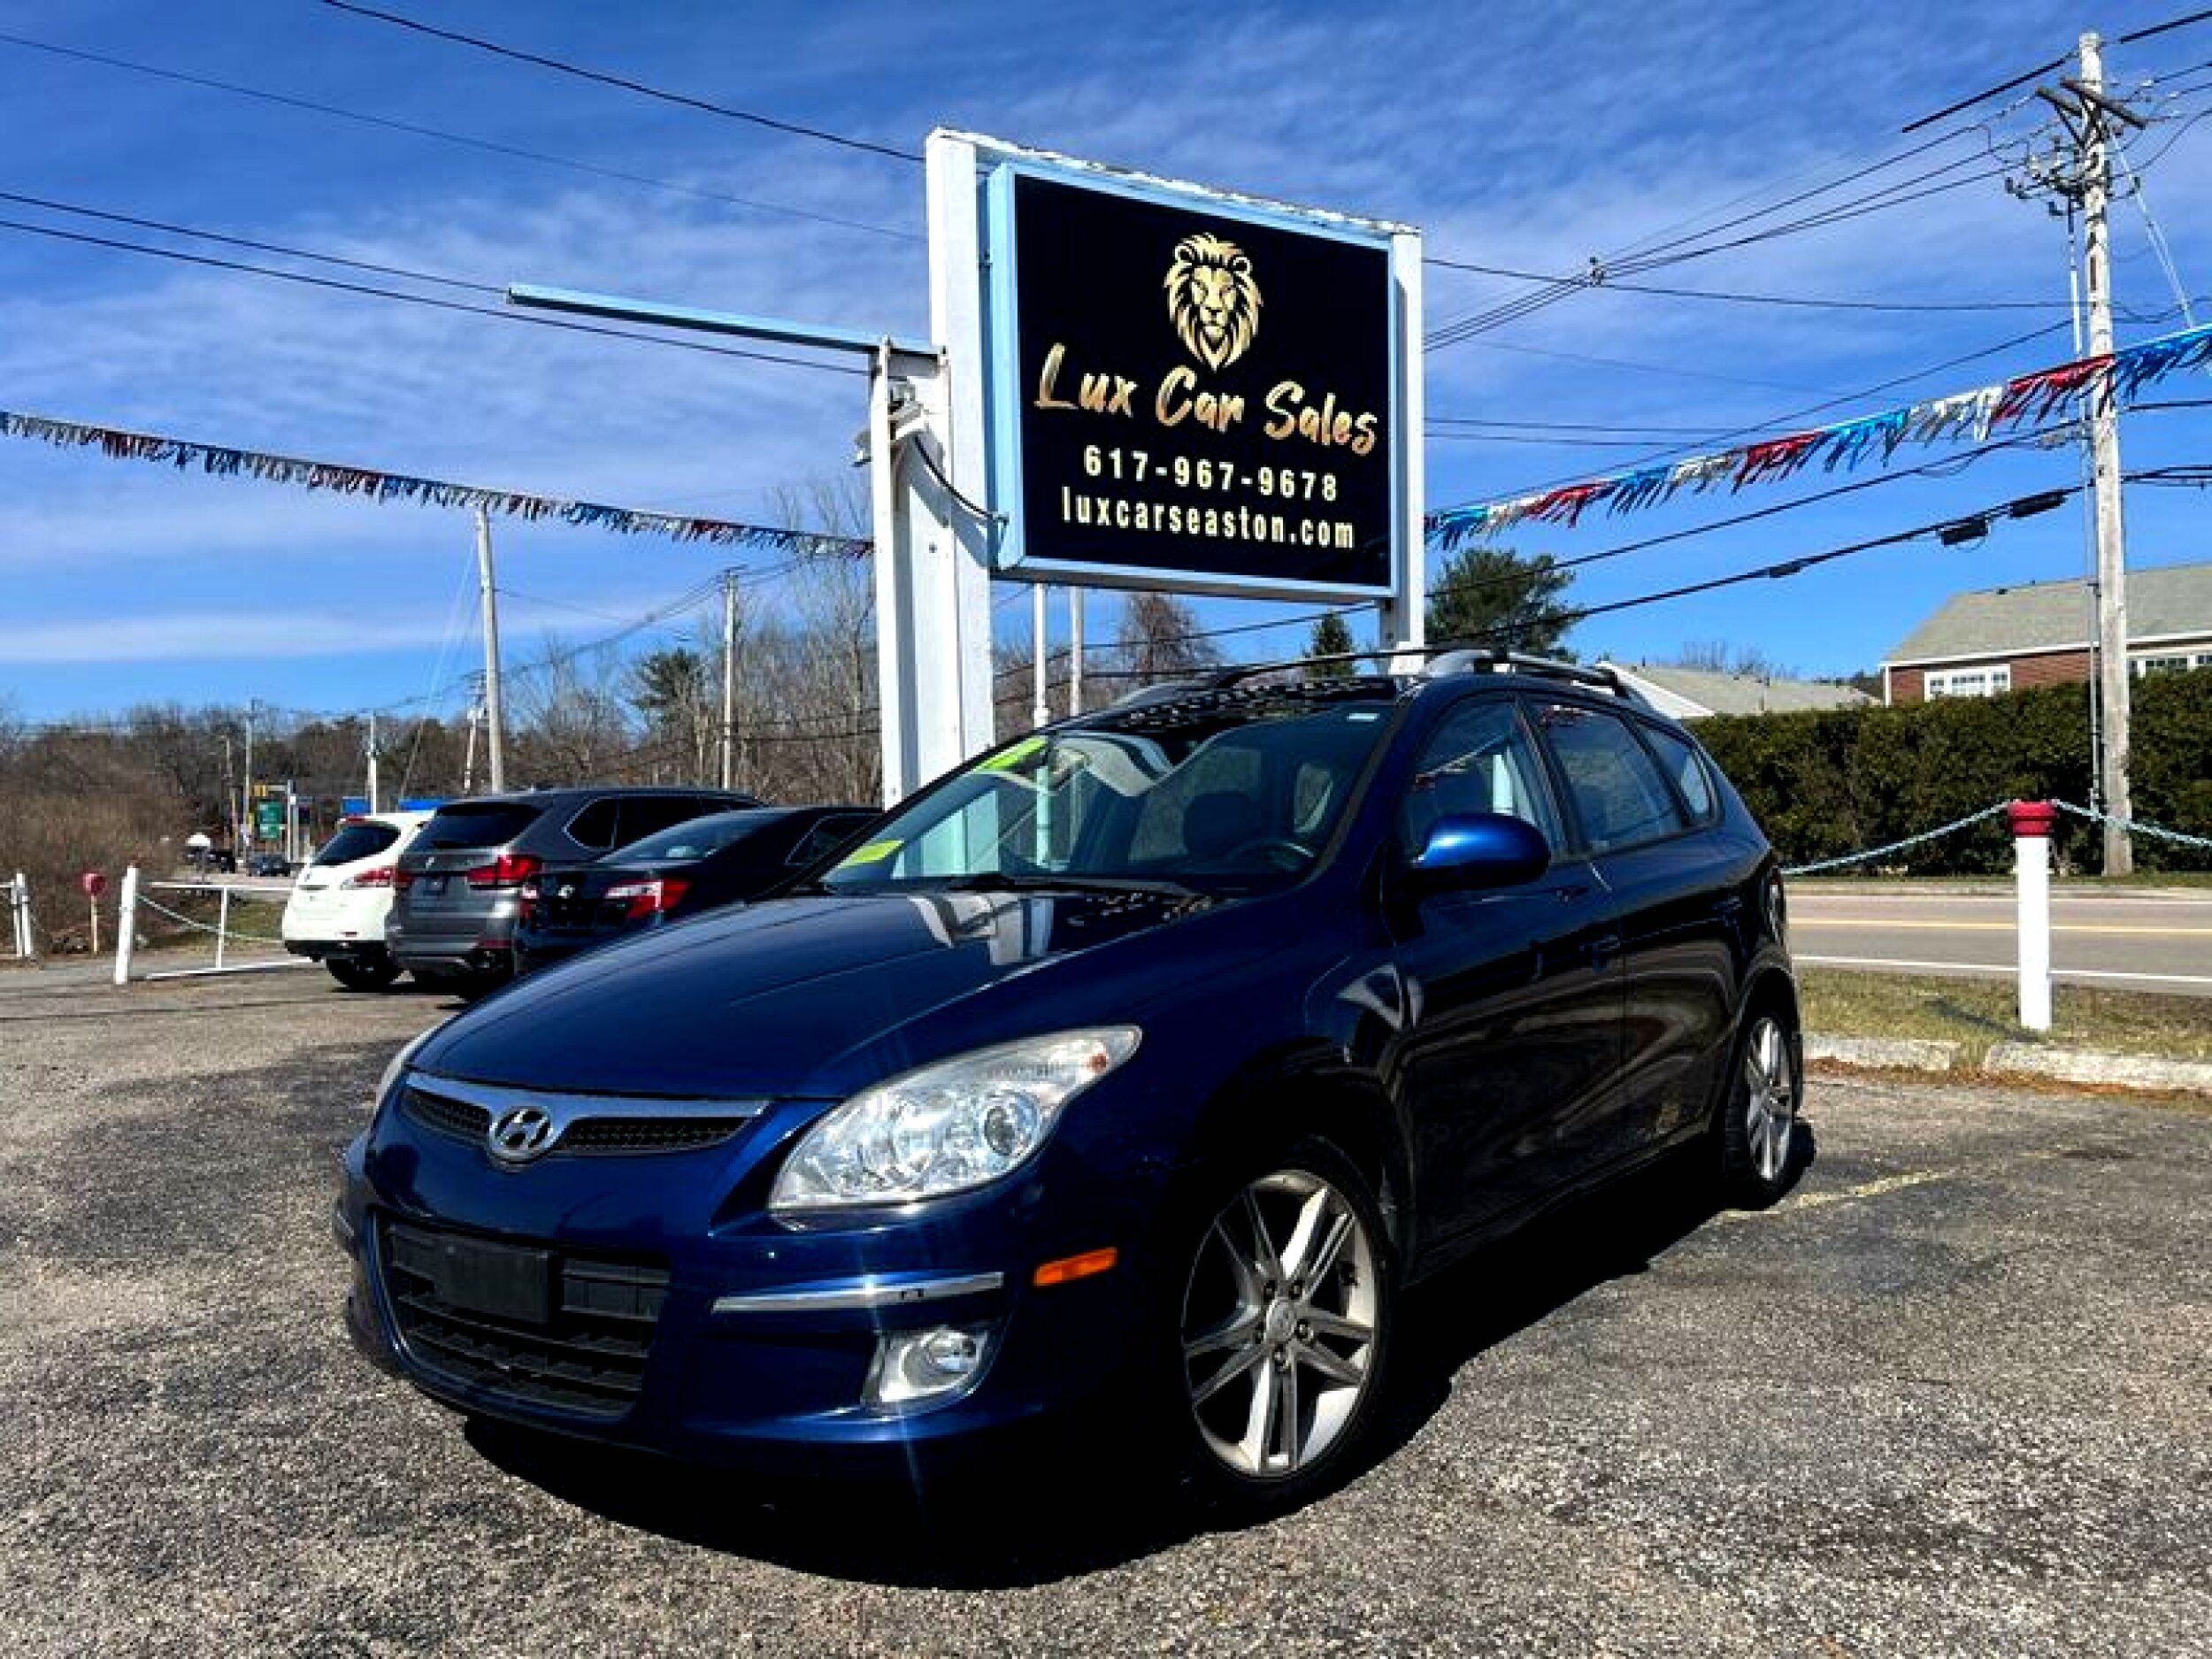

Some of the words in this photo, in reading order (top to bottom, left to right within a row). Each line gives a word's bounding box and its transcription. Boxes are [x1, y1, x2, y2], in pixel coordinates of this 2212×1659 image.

[1033, 342, 1138, 418] Lux
[1156, 365, 1245, 434] Car
[1263, 380, 1378, 456] Sales
[1083, 444, 1339, 502] 617-967-9678
[1061, 486, 1354, 549] luxcarseaston.com
